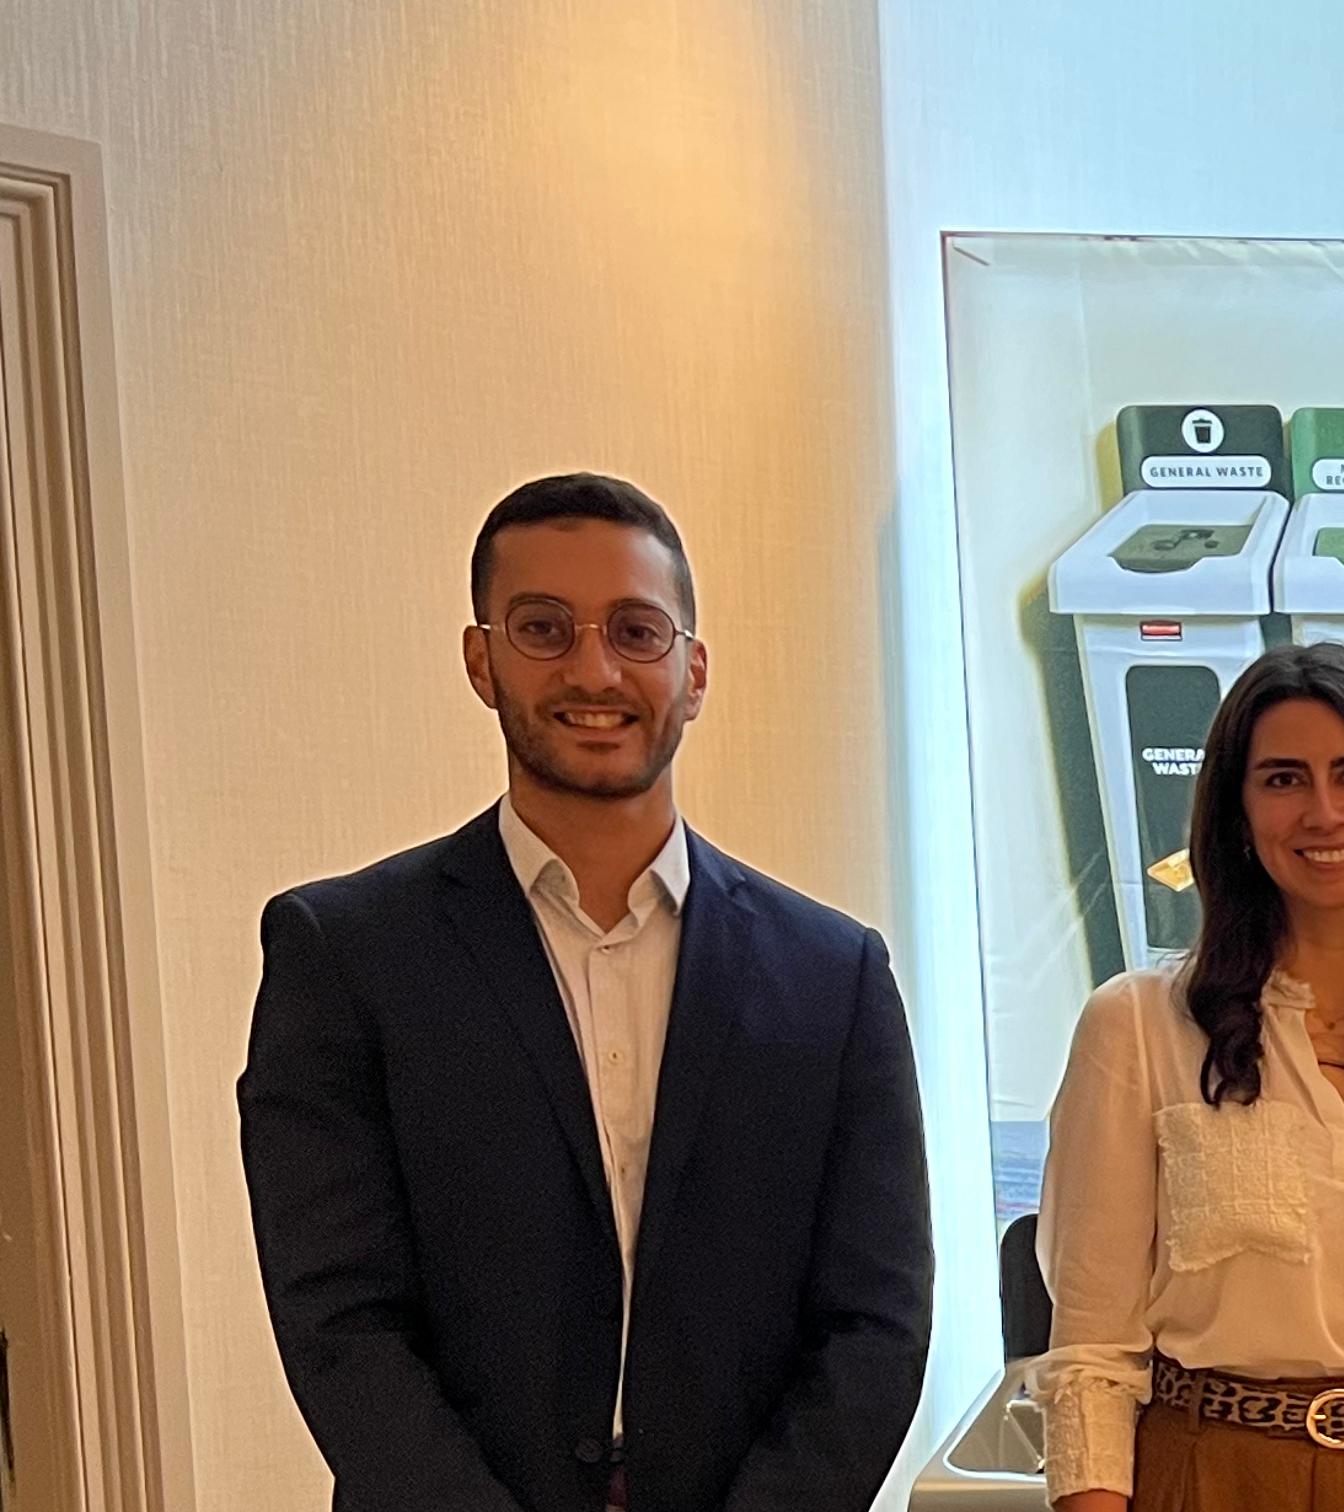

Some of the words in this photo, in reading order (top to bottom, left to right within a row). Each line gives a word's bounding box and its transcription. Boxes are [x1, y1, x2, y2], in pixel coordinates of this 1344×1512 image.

[1149, 466, 1212, 478] GENERAL
[1215, 465, 1264, 477] WASTE
[1141, 747, 1206, 762] GENERA
[1151, 762, 1203, 776] WAST
